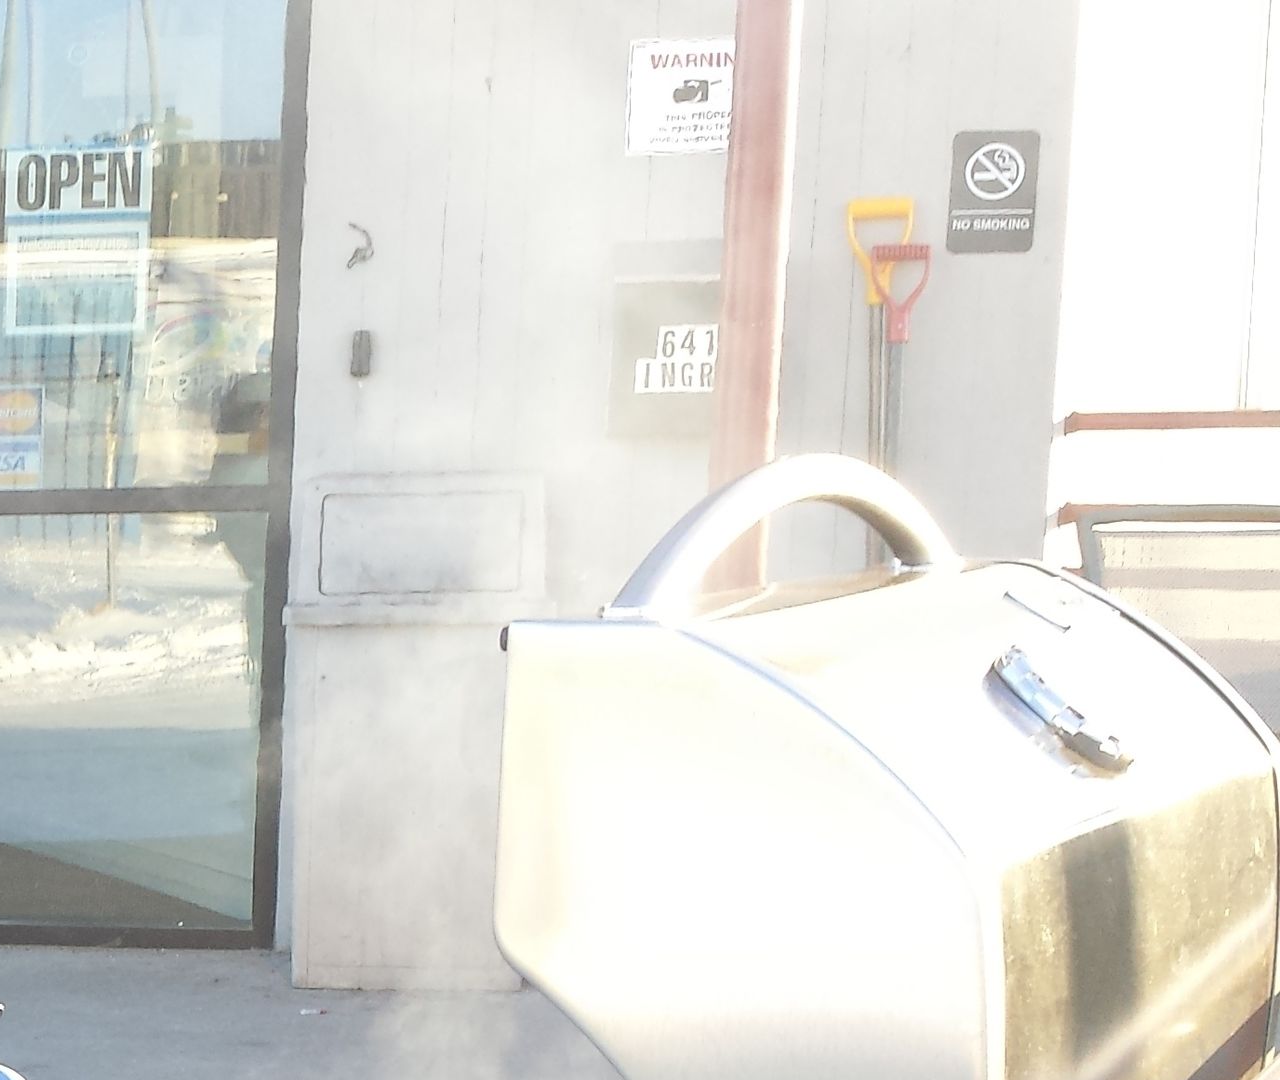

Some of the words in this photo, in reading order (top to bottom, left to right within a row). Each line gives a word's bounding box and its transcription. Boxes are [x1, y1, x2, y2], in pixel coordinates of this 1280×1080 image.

[16, 151, 142, 212] OPEN
[952, 219, 971, 231] NO
[973, 217, 1030, 231] SMOKING
